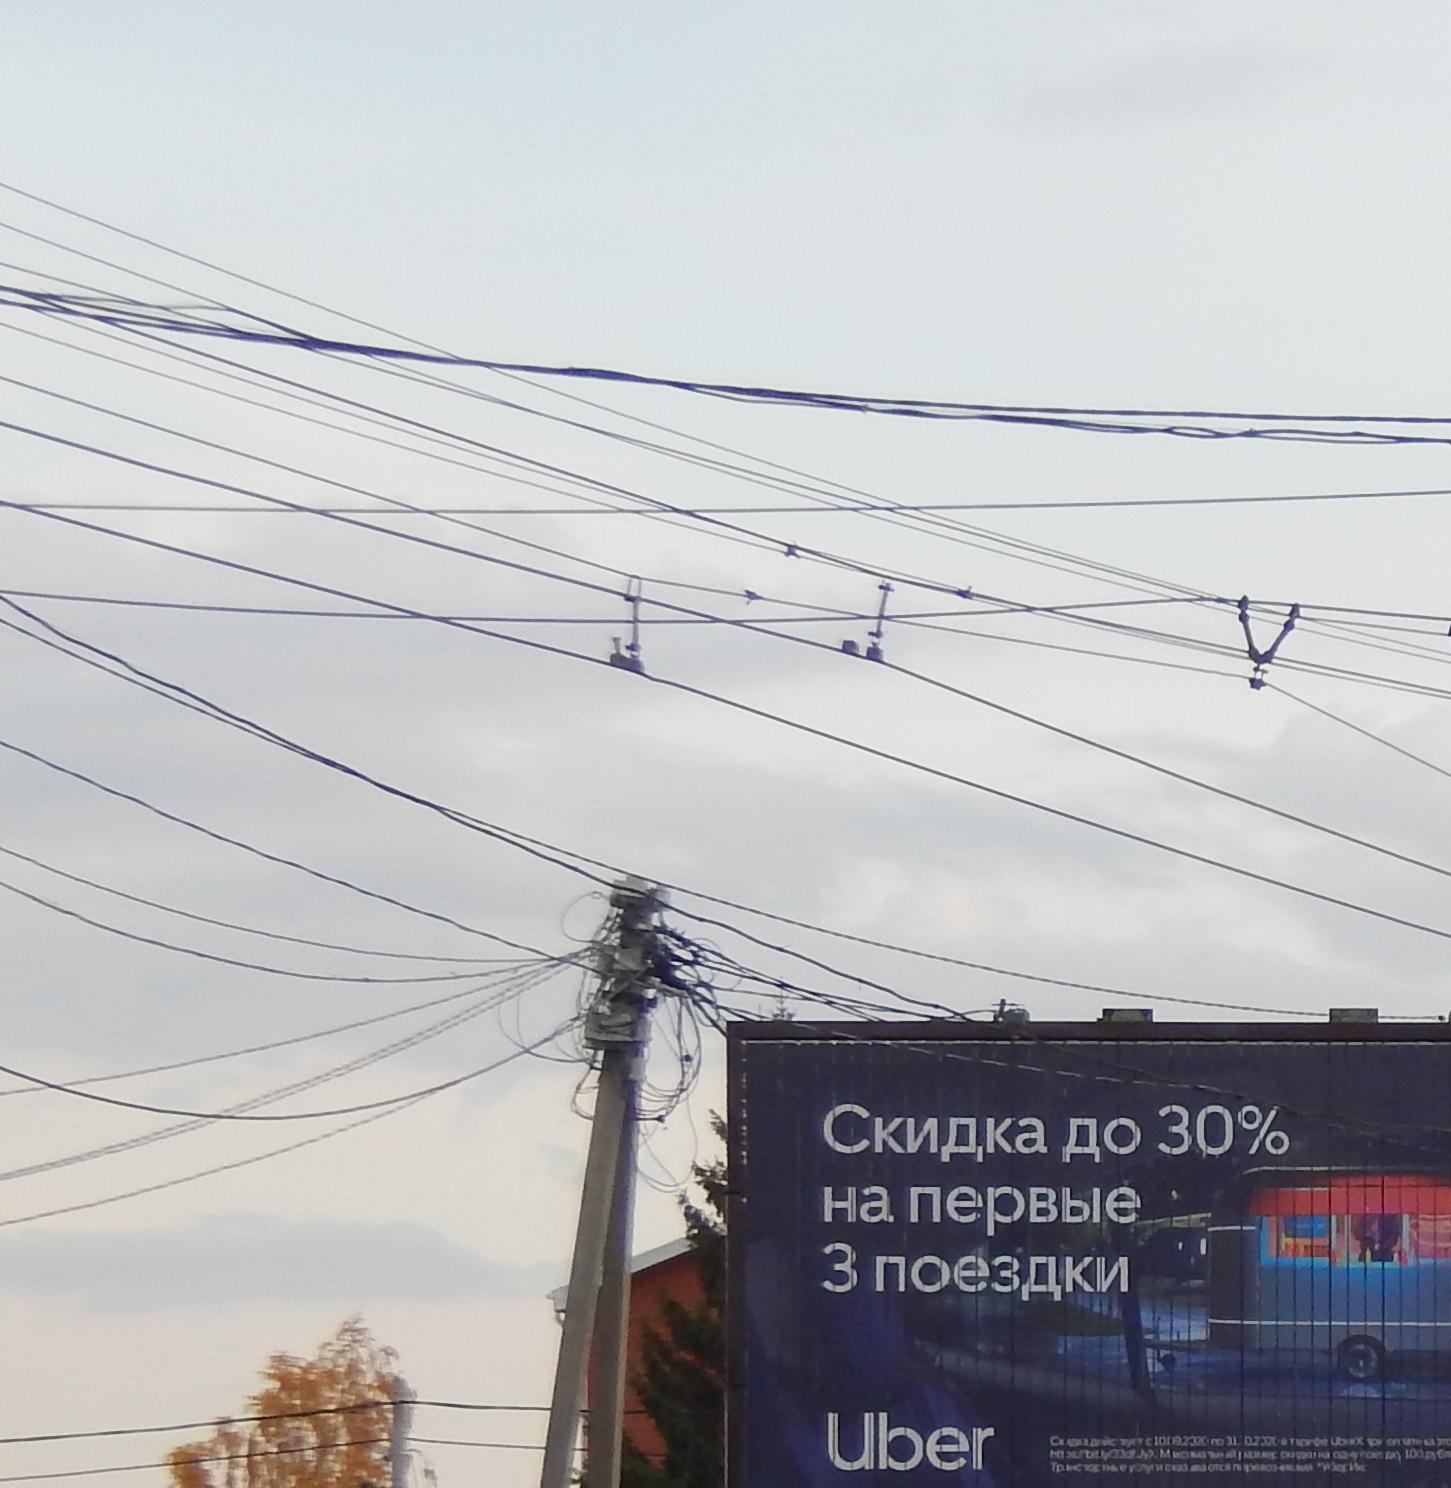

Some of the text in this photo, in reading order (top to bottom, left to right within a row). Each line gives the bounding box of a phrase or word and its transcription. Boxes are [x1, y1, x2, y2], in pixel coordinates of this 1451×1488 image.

[822, 1103, 1291, 1163] Скидка до 30%
[822, 1184, 1142, 1236] на первые
[821, 1241, 1130, 1301] 3 поездки
[827, 1412, 995, 1471] Uber
